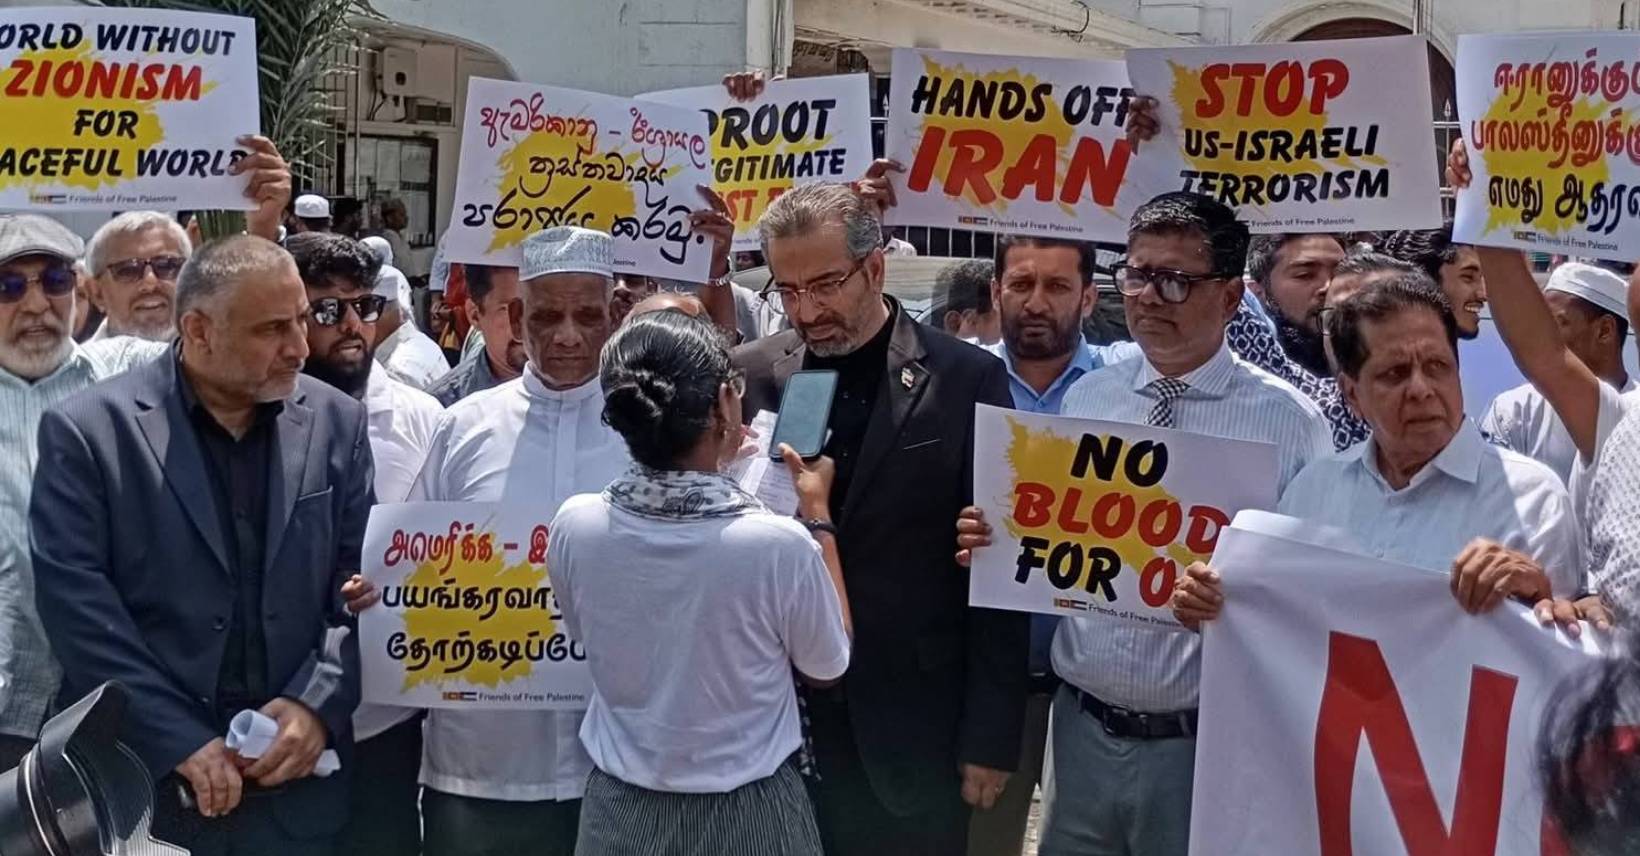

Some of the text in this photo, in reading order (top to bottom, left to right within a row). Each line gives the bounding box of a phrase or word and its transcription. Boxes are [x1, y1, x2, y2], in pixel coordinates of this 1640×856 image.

[97, 24, 235, 56] WITHOUT
[5, 59, 202, 101] ZIONISM
[1195, 58, 1349, 118] STOP
[911, 75, 1136, 127] HANDS OFF
[73, 109, 139, 139] FOR
[1184, 124, 1379, 163] US-ISRAELI
[0, 147, 248, 178] ACEFUL WORLD
[711, 148, 847, 184] GITIMATE
[906, 125, 1134, 207] IRAN
[1180, 168, 1389, 206] TERRORISM
[1489, 175, 1544, 224] எமது
[611, 197, 706, 265] කරමු
[990, 218, 1018, 228] Friends
[1030, 221, 1048, 230] Free
[1049, 223, 1084, 233] Palestine
[1251, 219, 1283, 228] Friends
[1296, 218, 1315, 226] Free
[1317, 217, 1356, 226] Palestine
[1571, 237, 1587, 248] Free
[1588, 239, 1618, 251] Palestine
[1070, 432, 1169, 488] NO
[1013, 481, 1231, 554] BLOOD
[384, 520, 493, 576] அமெரிக்க
[1014, 535, 1122, 603] FOR
[1088, 603, 1118, 617] Friends
[1130, 612, 1149, 622] Free
[479, 691, 585, 702] Friends of Free Palestine
